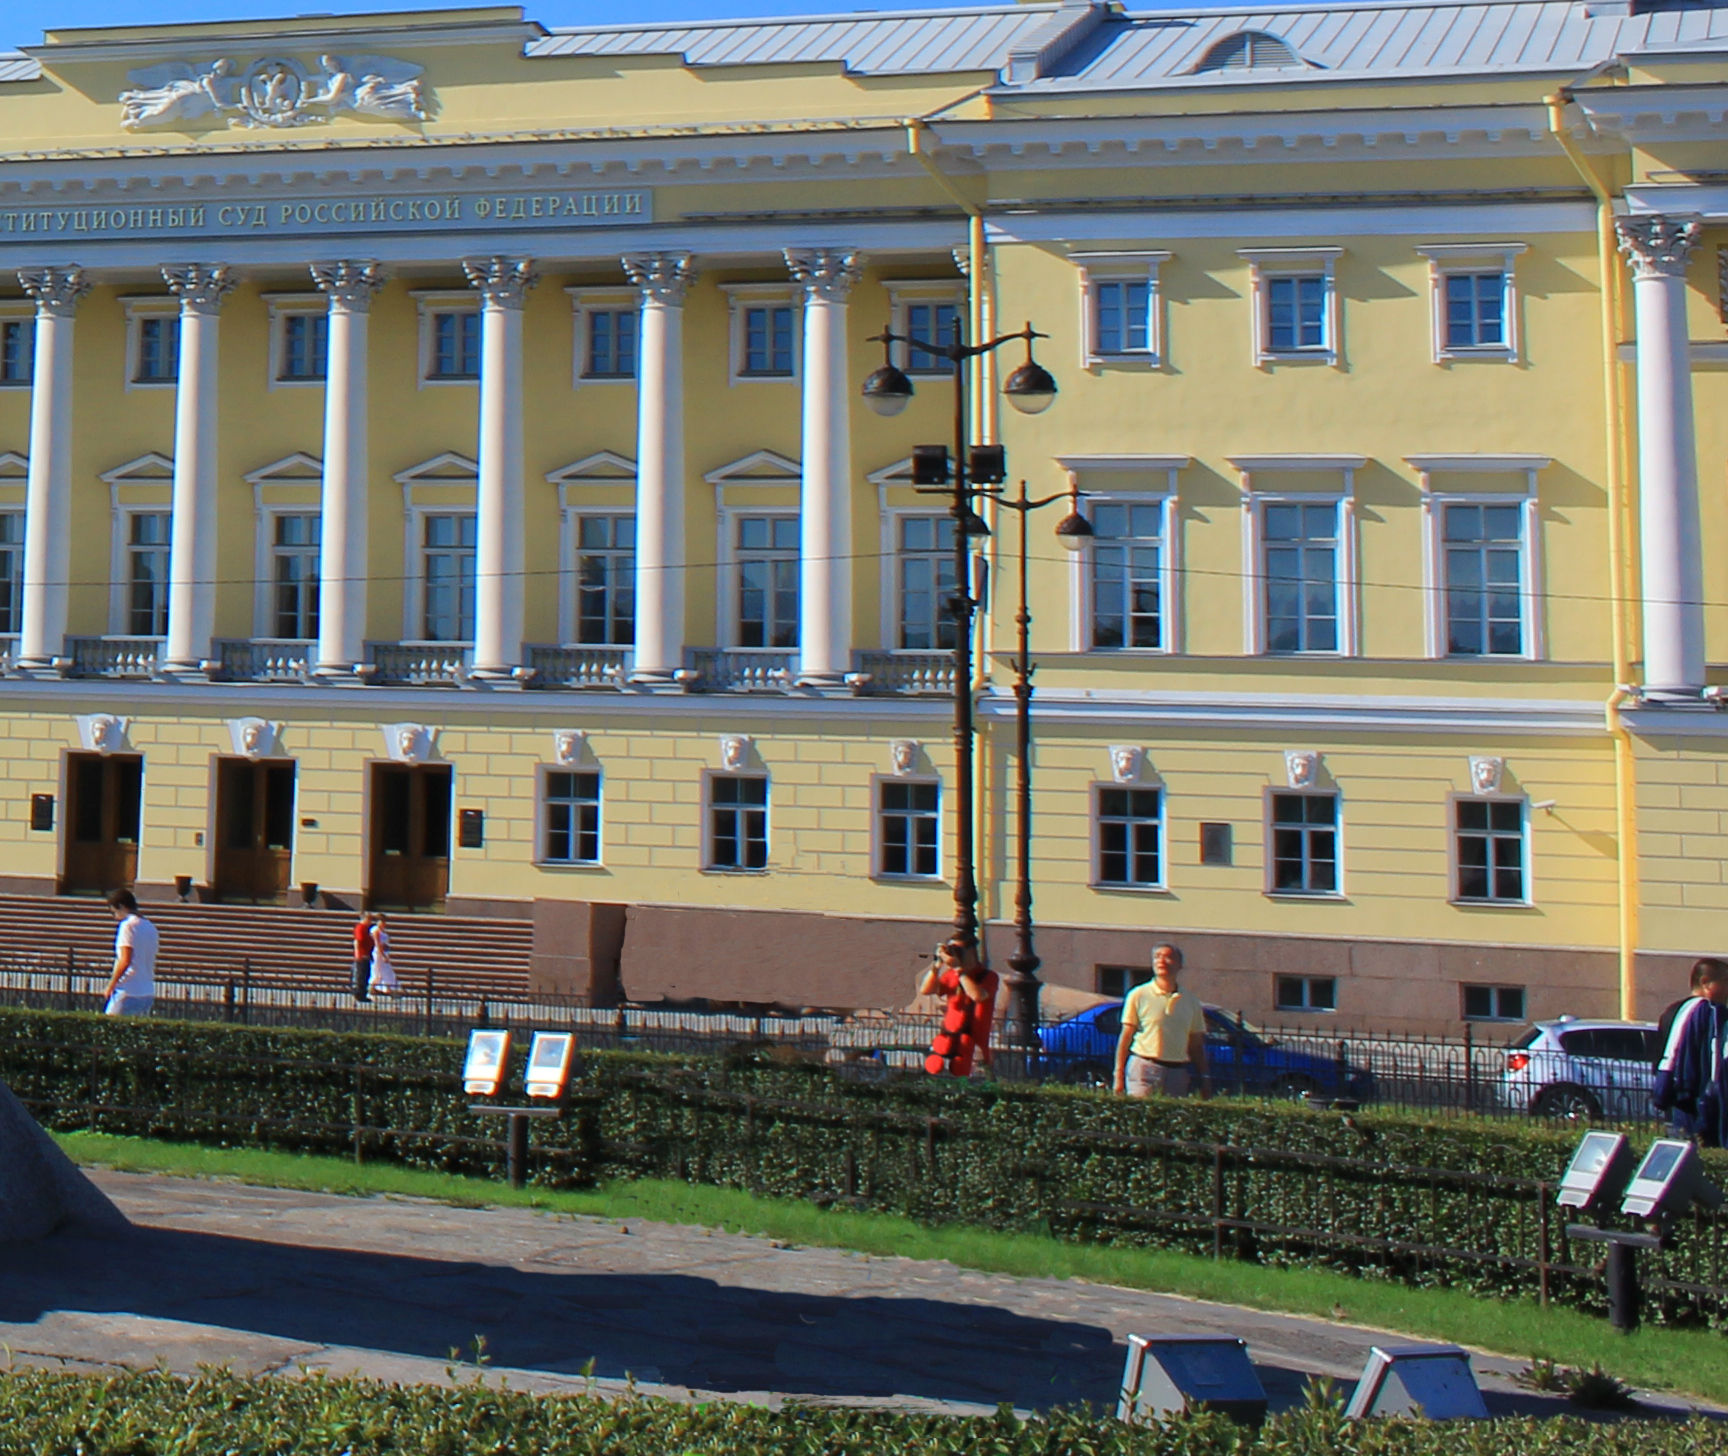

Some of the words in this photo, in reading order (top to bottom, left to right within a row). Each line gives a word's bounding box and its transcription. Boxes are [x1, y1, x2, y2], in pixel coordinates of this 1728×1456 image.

[218, 205, 266, 228] СУД
[280, 196, 461, 225] РОССИЙСКОЙ
[475, 194, 642, 220] ФЕДЕРАЦИИ
